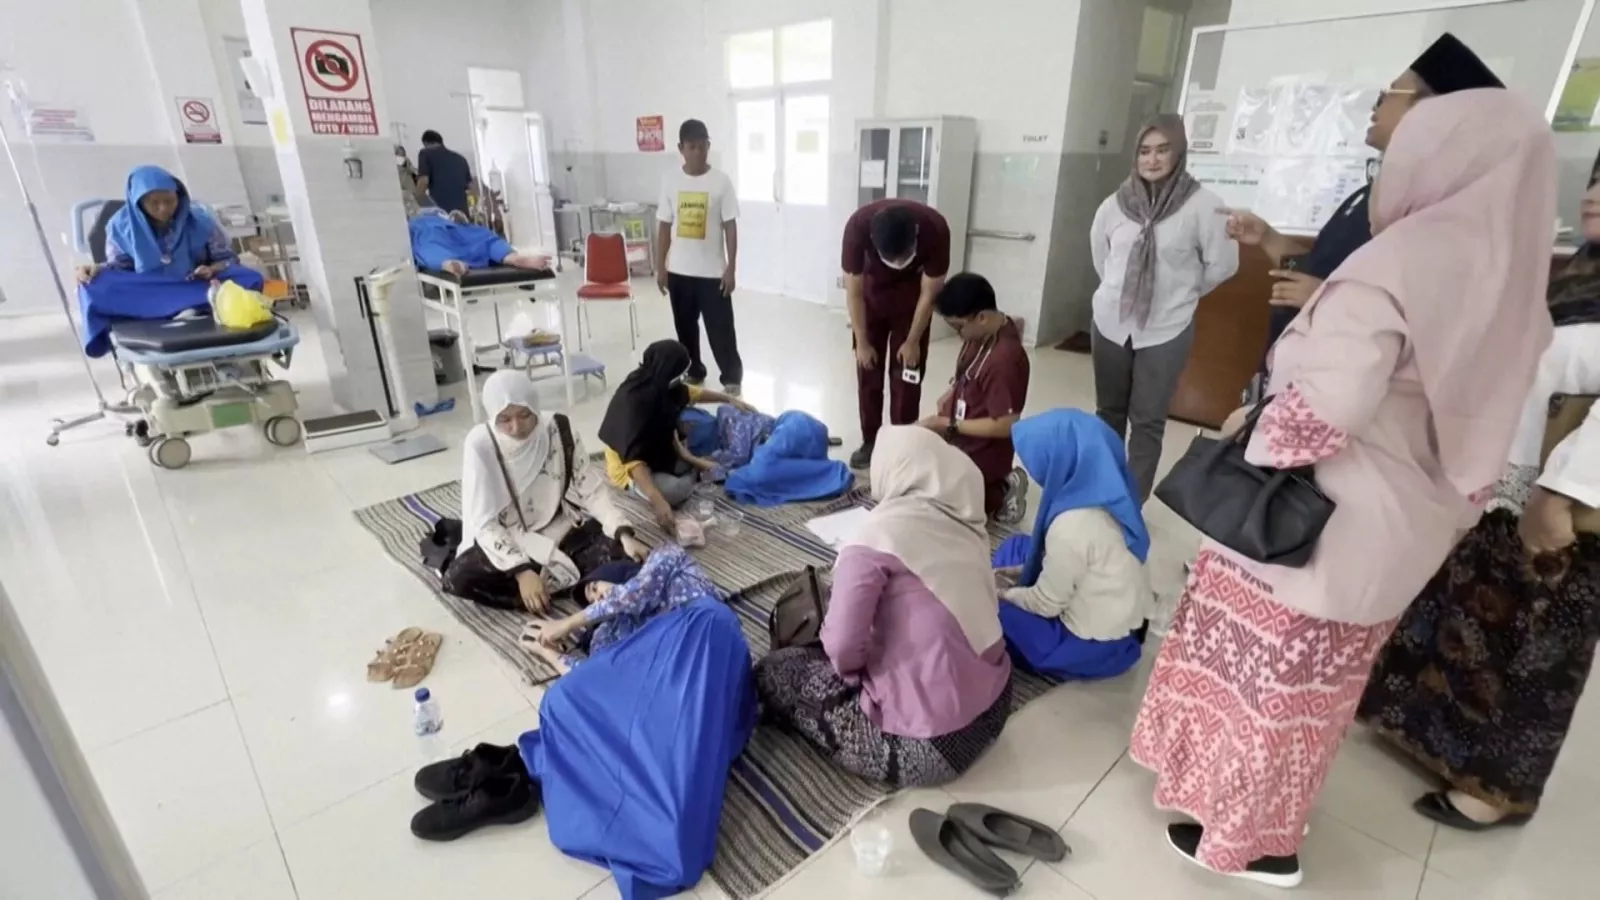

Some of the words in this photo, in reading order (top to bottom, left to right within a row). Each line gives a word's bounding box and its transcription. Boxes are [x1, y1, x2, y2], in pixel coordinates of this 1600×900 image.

[308, 99, 372, 112] DILARANG
[311, 112, 373, 123] MENGAMBIL
[314, 123, 339, 133] FOTO
[347, 123, 376, 134] VIDEO
